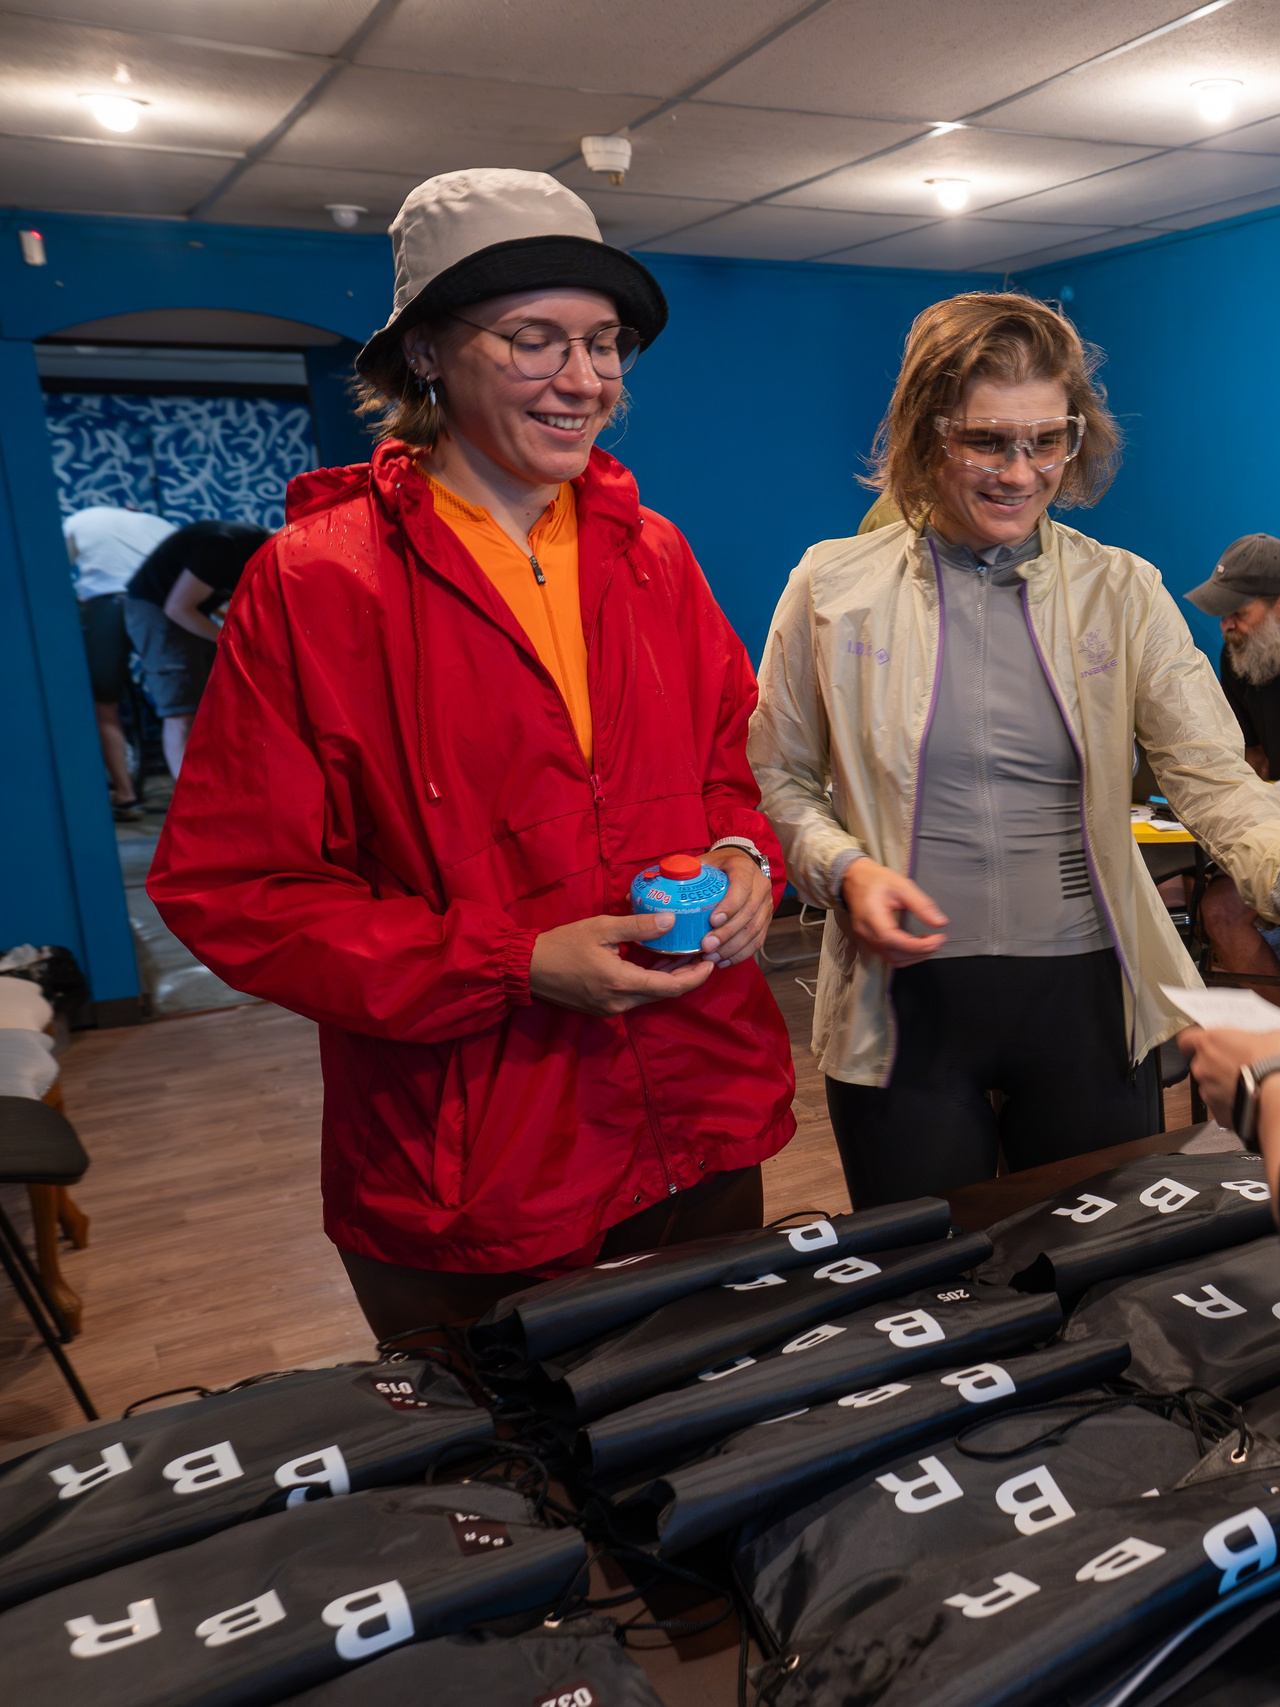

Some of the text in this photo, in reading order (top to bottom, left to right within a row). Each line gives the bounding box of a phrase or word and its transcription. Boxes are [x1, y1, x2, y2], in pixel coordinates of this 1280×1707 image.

[646, 888, 671, 904] 110g
[937, 1288, 970, 1303] 205
[375, 1382, 413, 1395] 015
